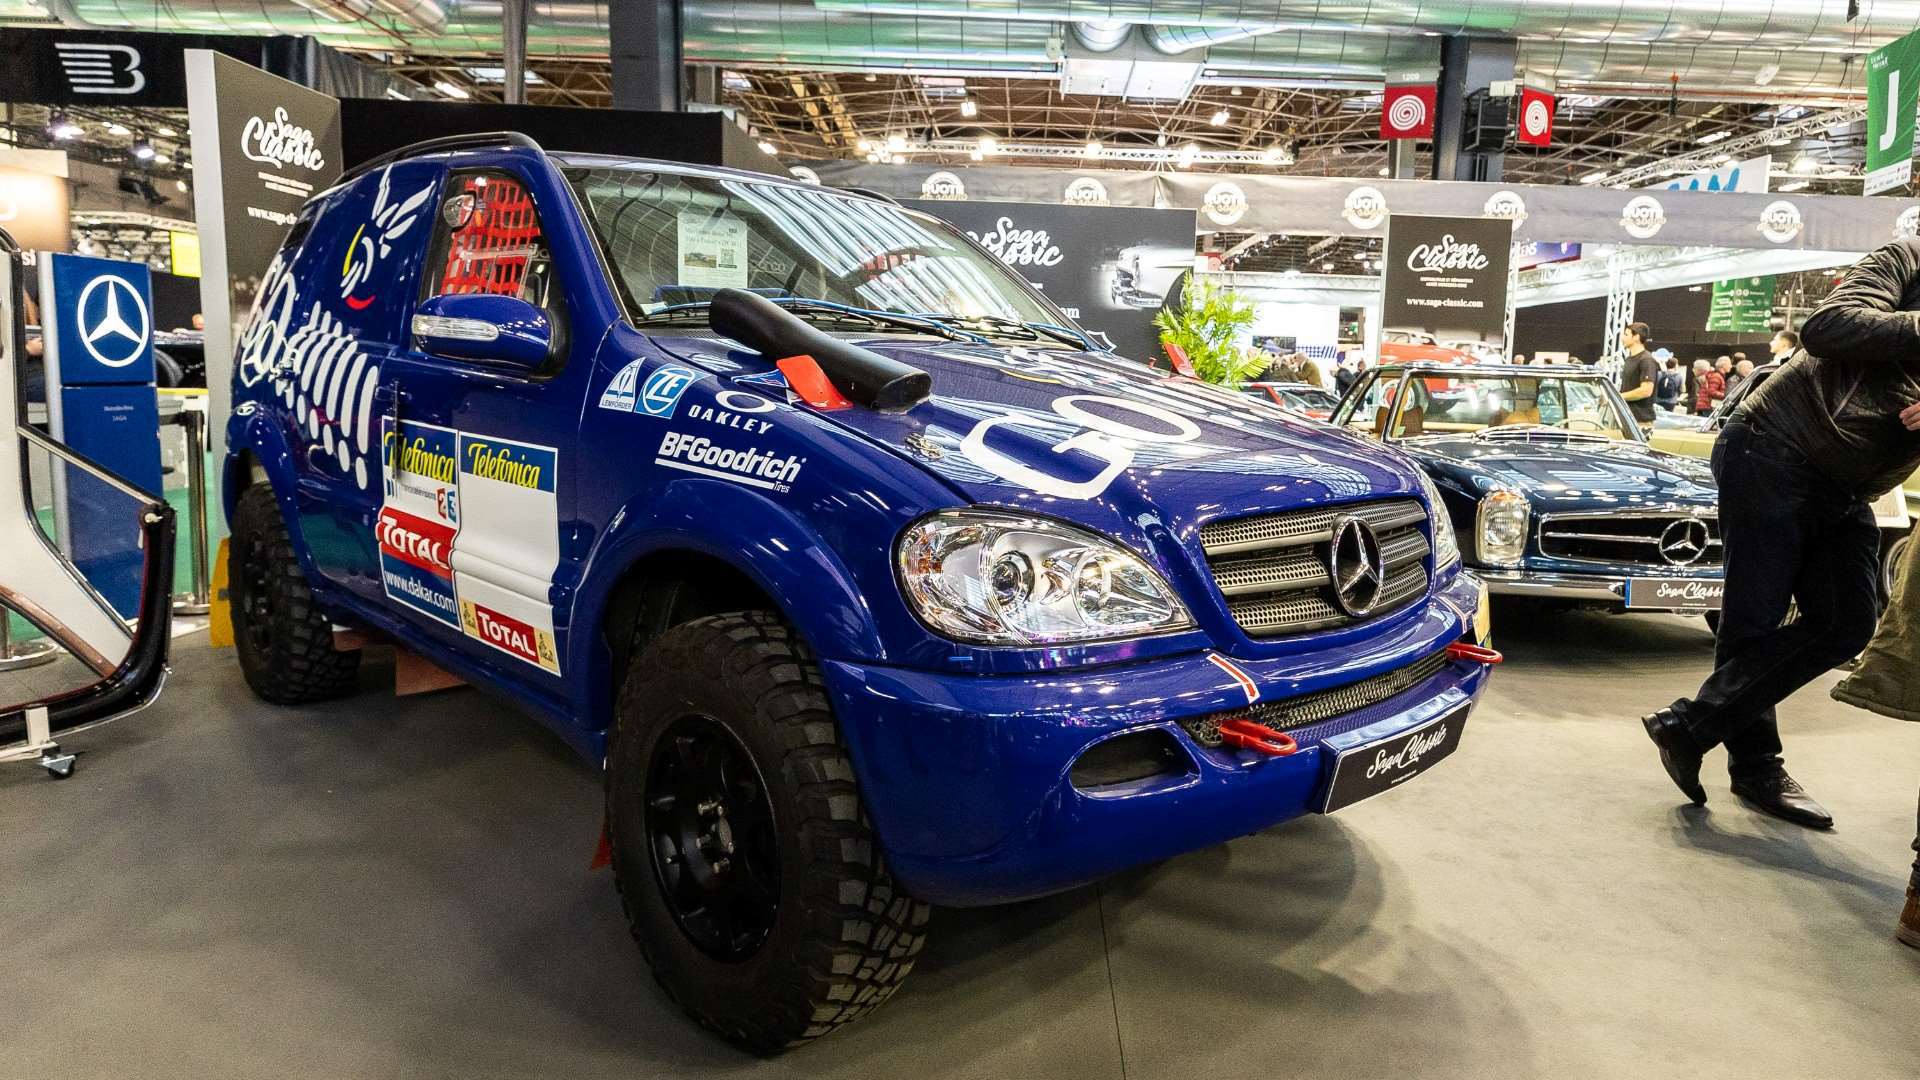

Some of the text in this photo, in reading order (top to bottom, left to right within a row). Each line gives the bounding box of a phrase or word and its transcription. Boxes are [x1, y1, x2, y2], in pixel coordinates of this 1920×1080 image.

[1880, 70, 1900, 152] J
[241, 116, 325, 171] Classic
[989, 216, 1051, 248] Saga
[1434, 234, 1481, 258] Saga
[1407, 244, 1489, 273] Classic
[688, 404, 774, 435] OAKLEY
[658, 431, 801, 483] BFGoodrich
[382, 515, 450, 570] TOTAL
[385, 570, 457, 615] www.dakar.com
[478, 610, 537, 657] TOTAL
